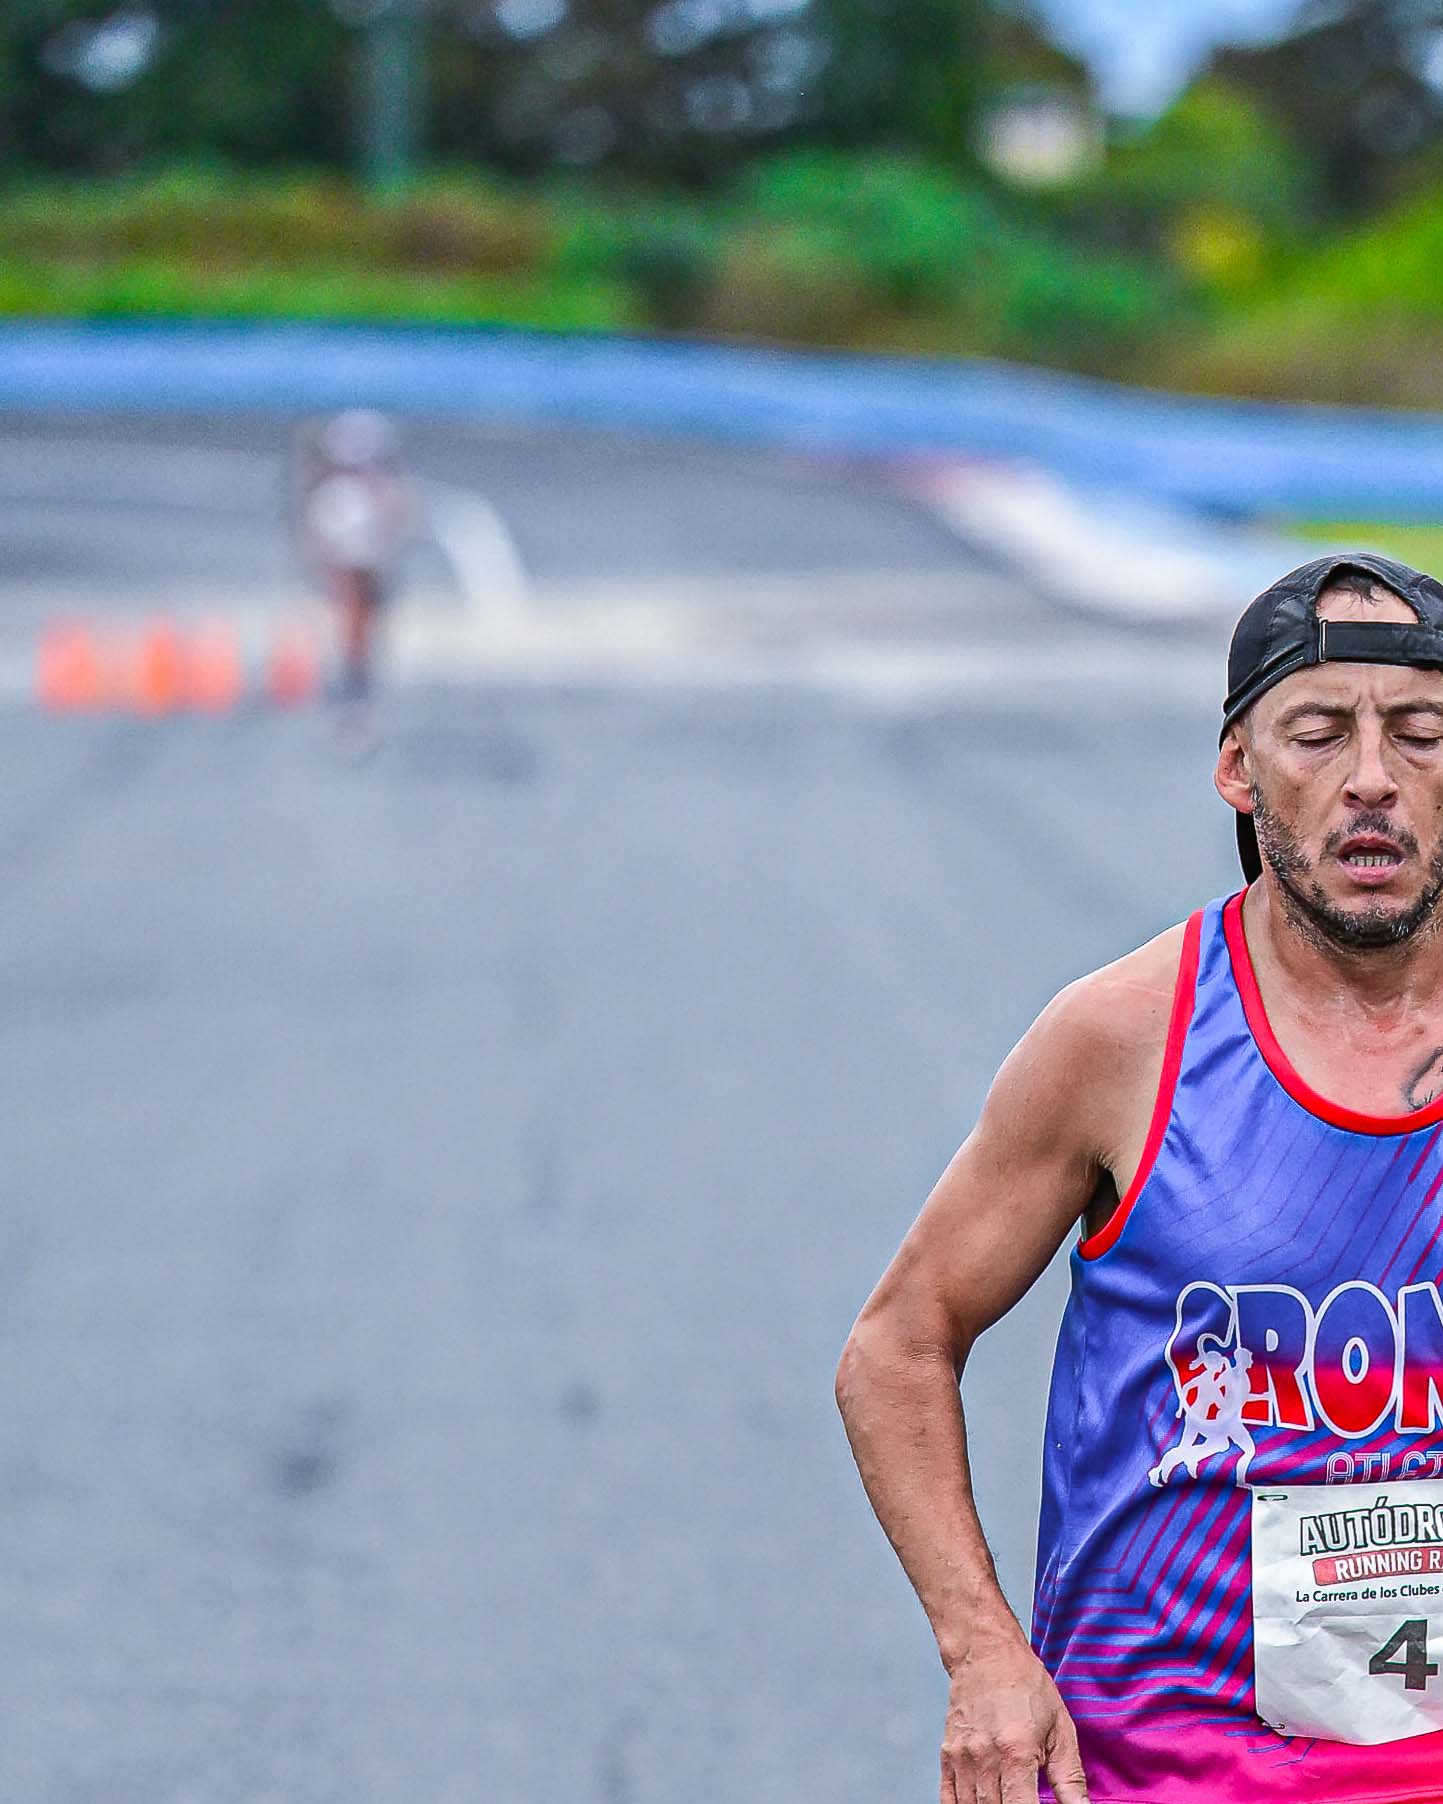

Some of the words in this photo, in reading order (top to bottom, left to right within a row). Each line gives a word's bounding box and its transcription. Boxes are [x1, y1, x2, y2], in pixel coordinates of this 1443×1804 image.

[1334, 1551, 1422, 1581] RUNNING
[1295, 1590, 1310, 1603] La
[1313, 1590, 1358, 1602] Carrera
[1361, 1587, 1377, 1600] de
[1380, 1586, 1398, 1599] los
[1400, 1583, 1438, 1597] Clubes
[1368, 1618, 1439, 1691] 4
